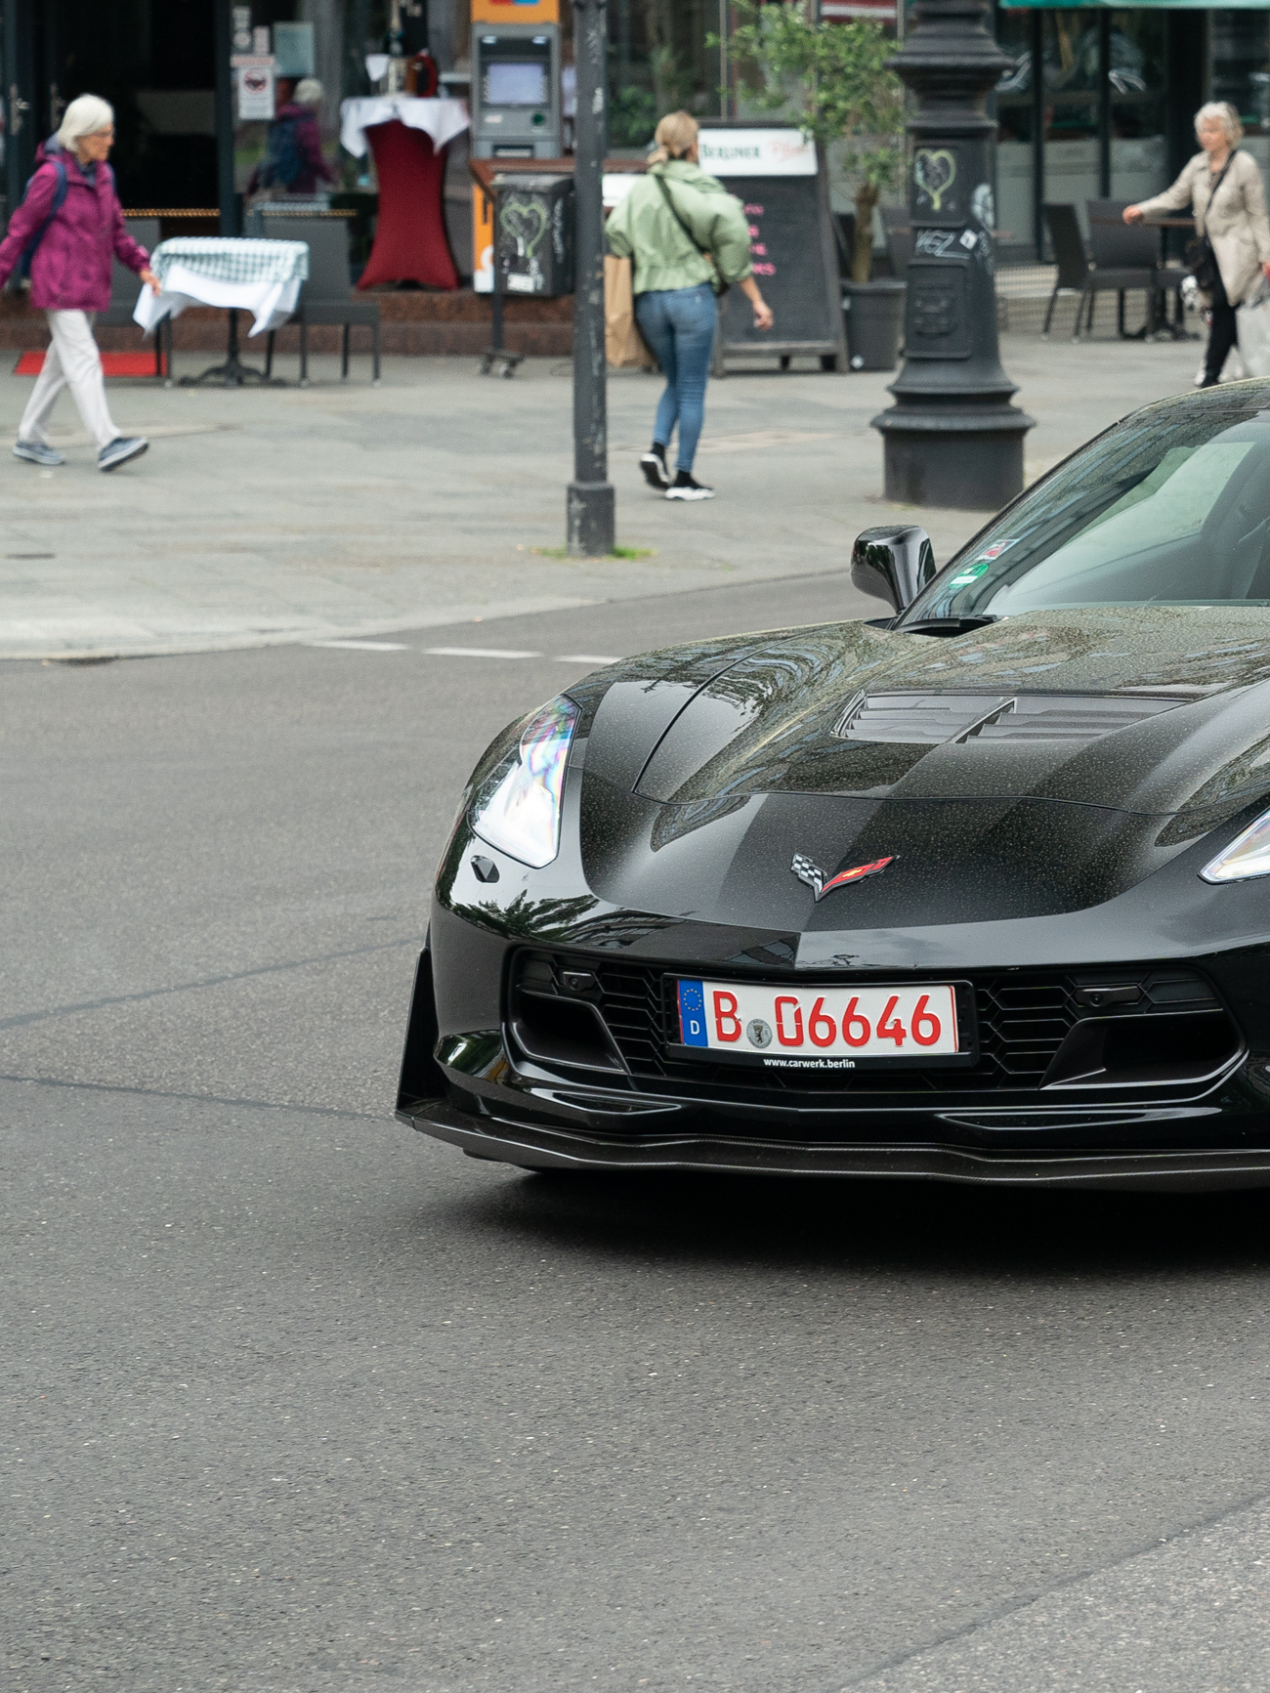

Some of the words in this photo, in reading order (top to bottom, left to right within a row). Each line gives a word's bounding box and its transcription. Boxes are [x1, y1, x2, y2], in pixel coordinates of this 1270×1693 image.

[712, 989, 743, 1043] B
[774, 994, 942, 1048] 06646
[689, 1020, 701, 1036] D
[763, 1058, 856, 1069] www.carwerk.berlin
